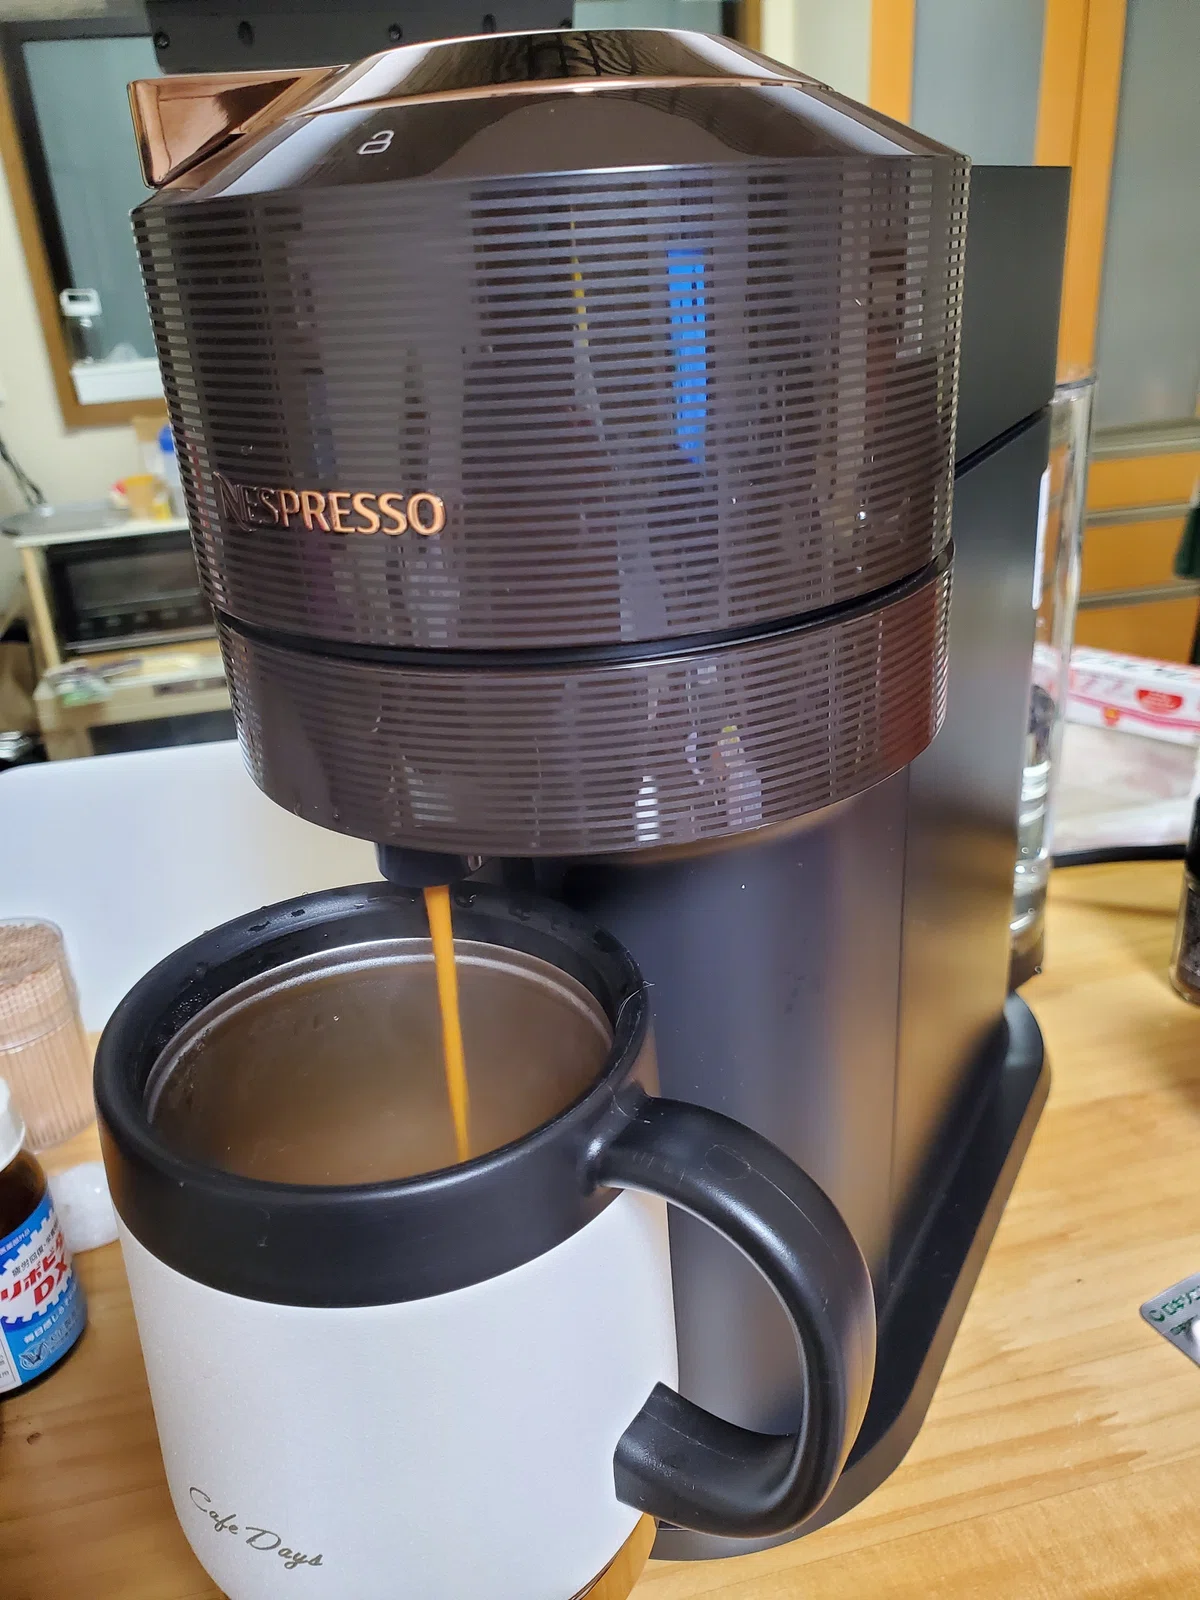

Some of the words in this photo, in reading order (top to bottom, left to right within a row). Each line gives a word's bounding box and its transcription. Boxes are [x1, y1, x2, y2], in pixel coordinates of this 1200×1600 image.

[213, 471, 447, 536] NESPRESSO
[34, 1252, 68, 1306] DX
[189, 1486, 239, 1535] Cafe
[245, 1526, 323, 1570] Days
